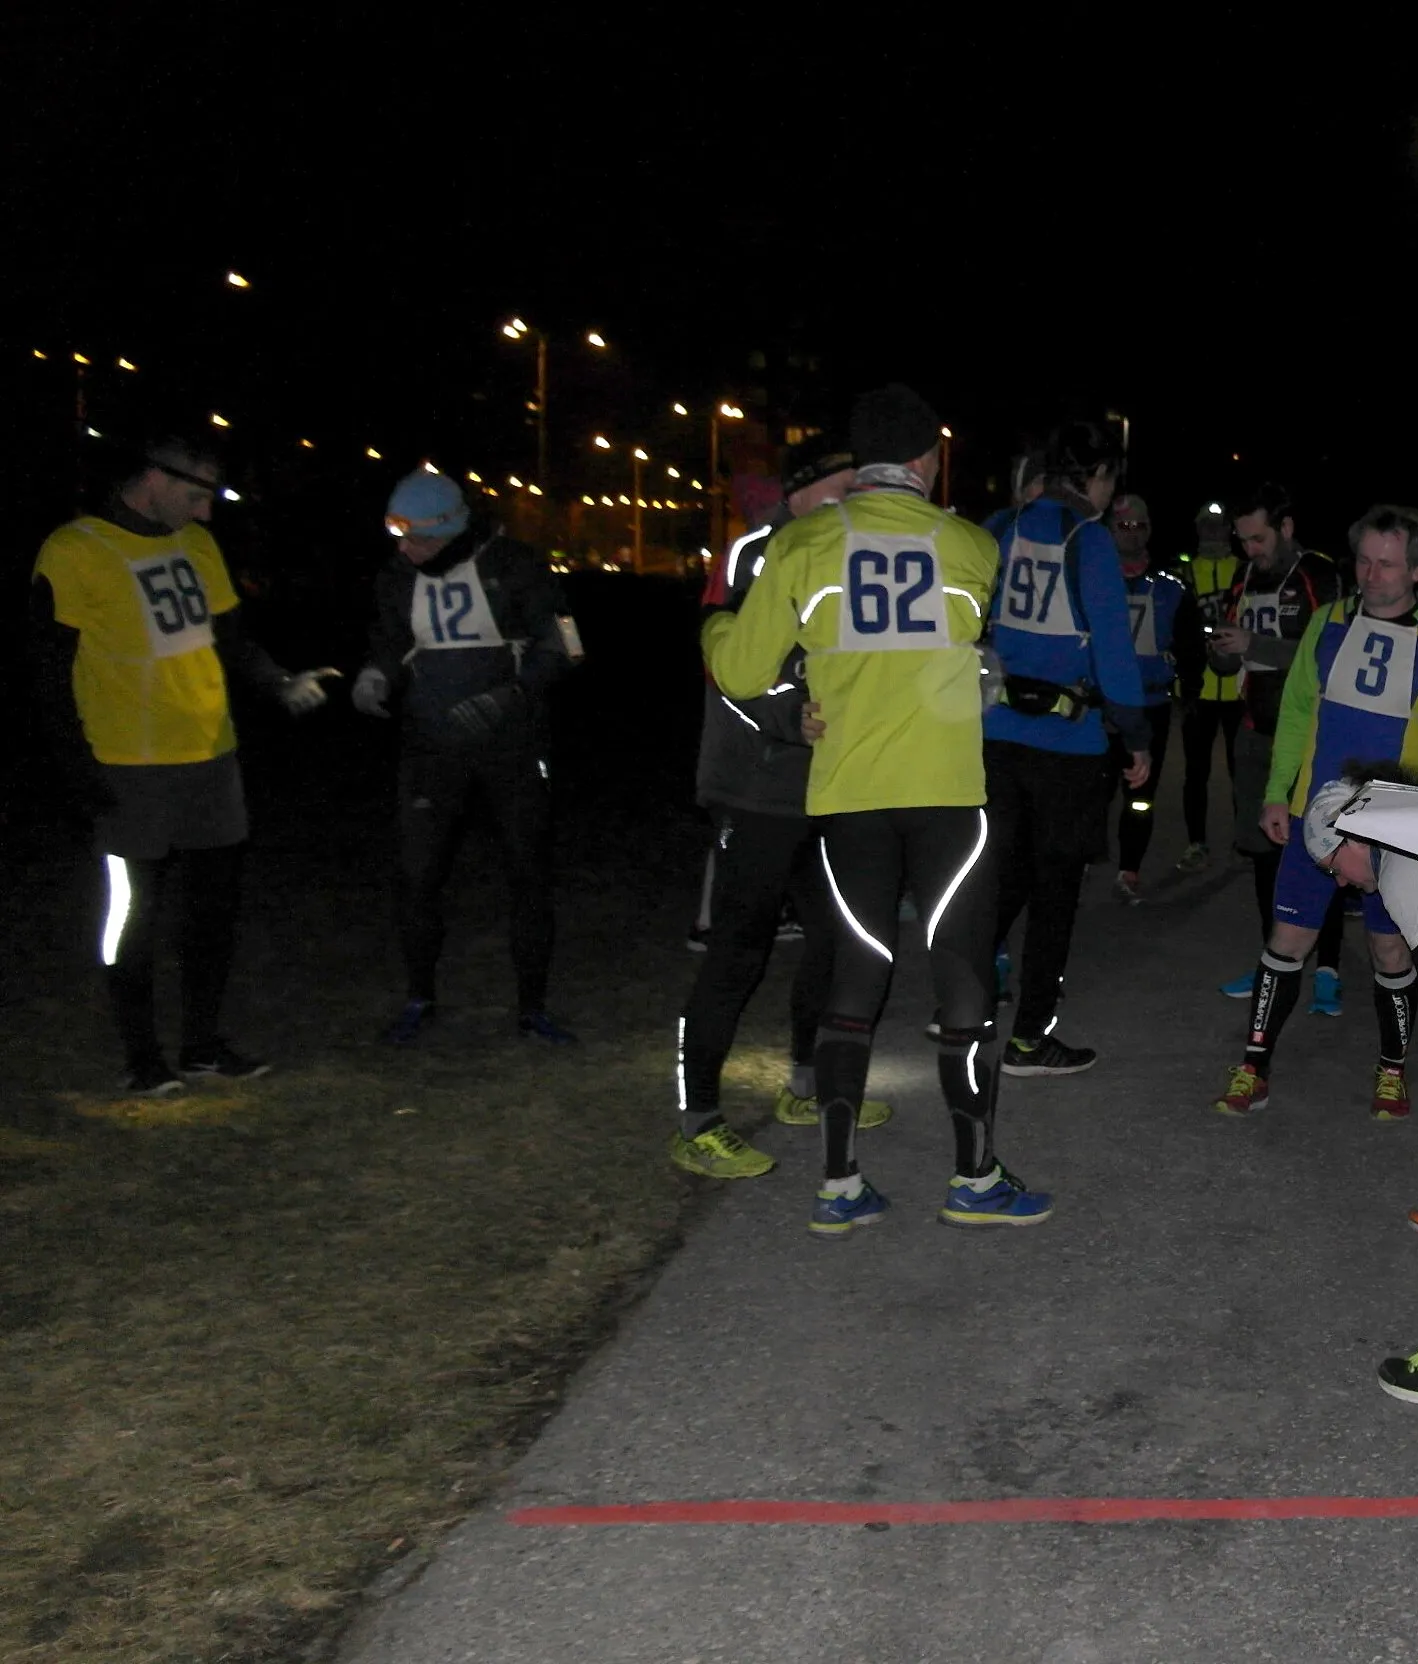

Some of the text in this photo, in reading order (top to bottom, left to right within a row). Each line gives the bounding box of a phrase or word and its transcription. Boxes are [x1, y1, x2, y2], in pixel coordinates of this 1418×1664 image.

[137, 558, 207, 633] 58
[427, 582, 481, 643] 12
[849, 550, 937, 634] 62
[1009, 557, 1062, 623] 97
[1355, 632, 1395, 697] 3
